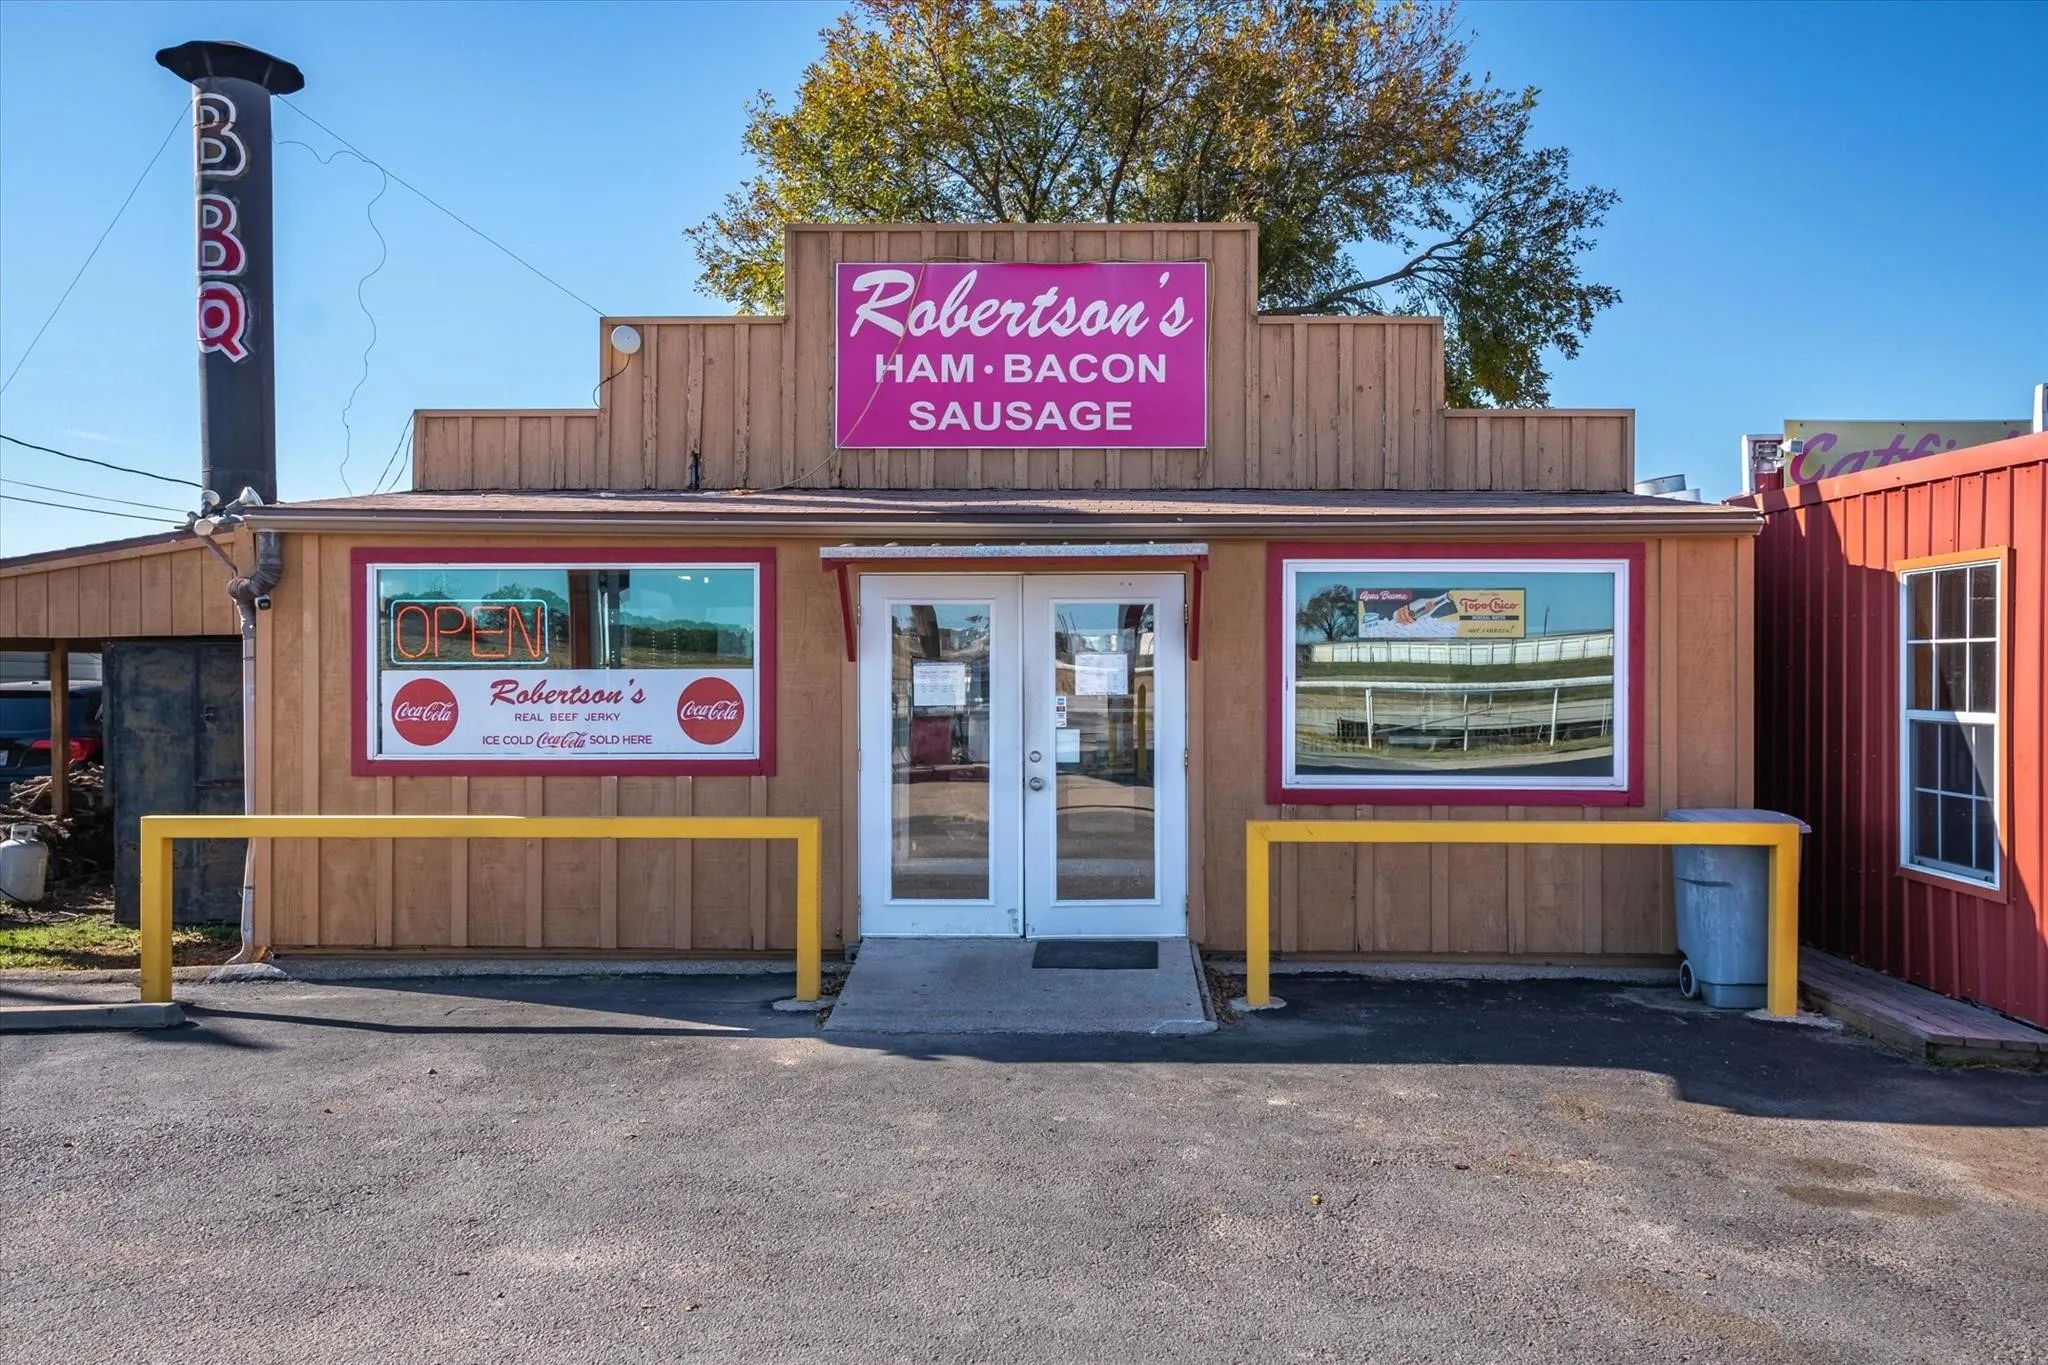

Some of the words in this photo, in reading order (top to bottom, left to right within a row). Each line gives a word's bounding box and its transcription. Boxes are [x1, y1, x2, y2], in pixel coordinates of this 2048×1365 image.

[850, 269, 1193, 338] Robertson's
[875, 353, 974, 383] HAM
[1004, 353, 1166, 383] BACON
[908, 400, 1133, 431] SAUSAGE
[1490, 597, 1519, 613] Chico
[396, 605, 542, 659] OPEN
[490, 678, 646, 706] Robertson's
[514, 712, 544, 722] REAL
[550, 712, 578, 722] BEEF
[584, 712, 620, 722] JERKY
[482, 735, 500, 745] ICE
[503, 735, 534, 745] COLD
[589, 735, 619, 745] SOLD
[622, 735, 653, 745] HERE
